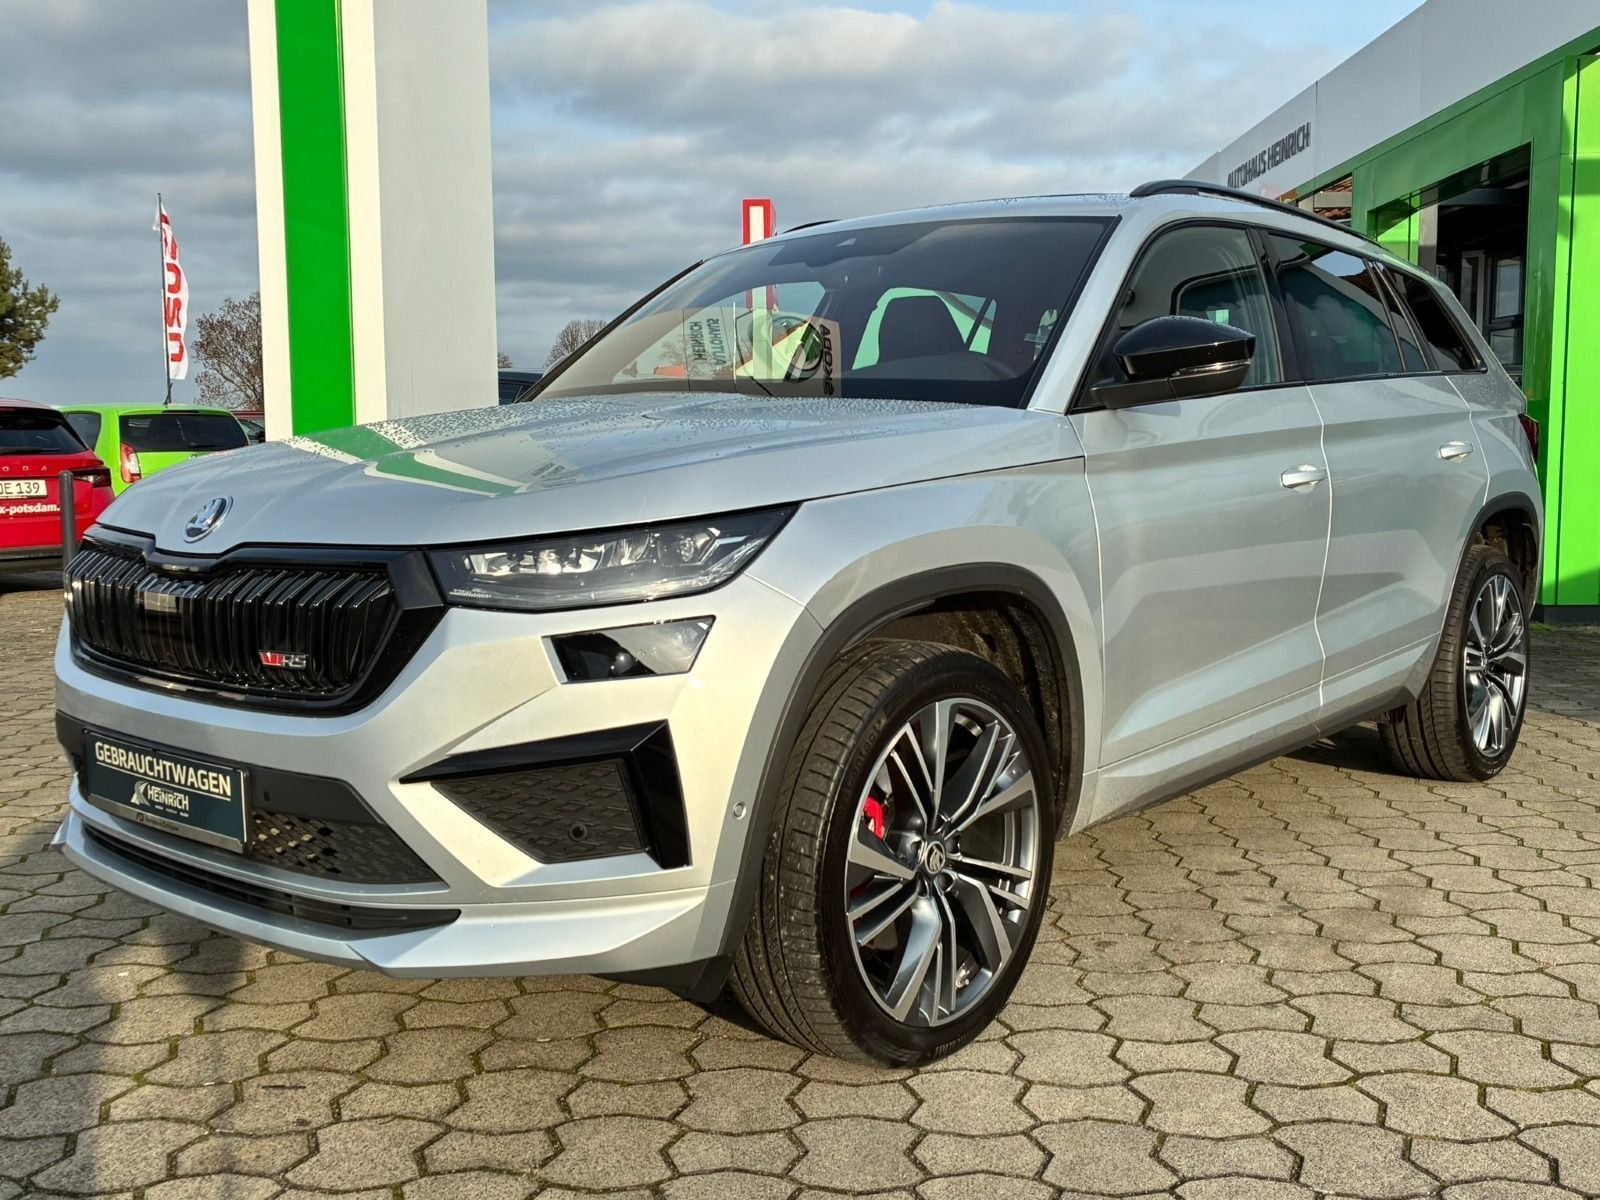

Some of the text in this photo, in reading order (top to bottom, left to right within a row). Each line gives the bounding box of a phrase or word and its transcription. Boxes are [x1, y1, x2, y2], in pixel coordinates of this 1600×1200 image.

[1227, 122, 1311, 189] AUTOHAUS HEINRICH
[16, 482, 40, 495] 139
[95, 741, 231, 797] GEBRAUCHTWAGEN
